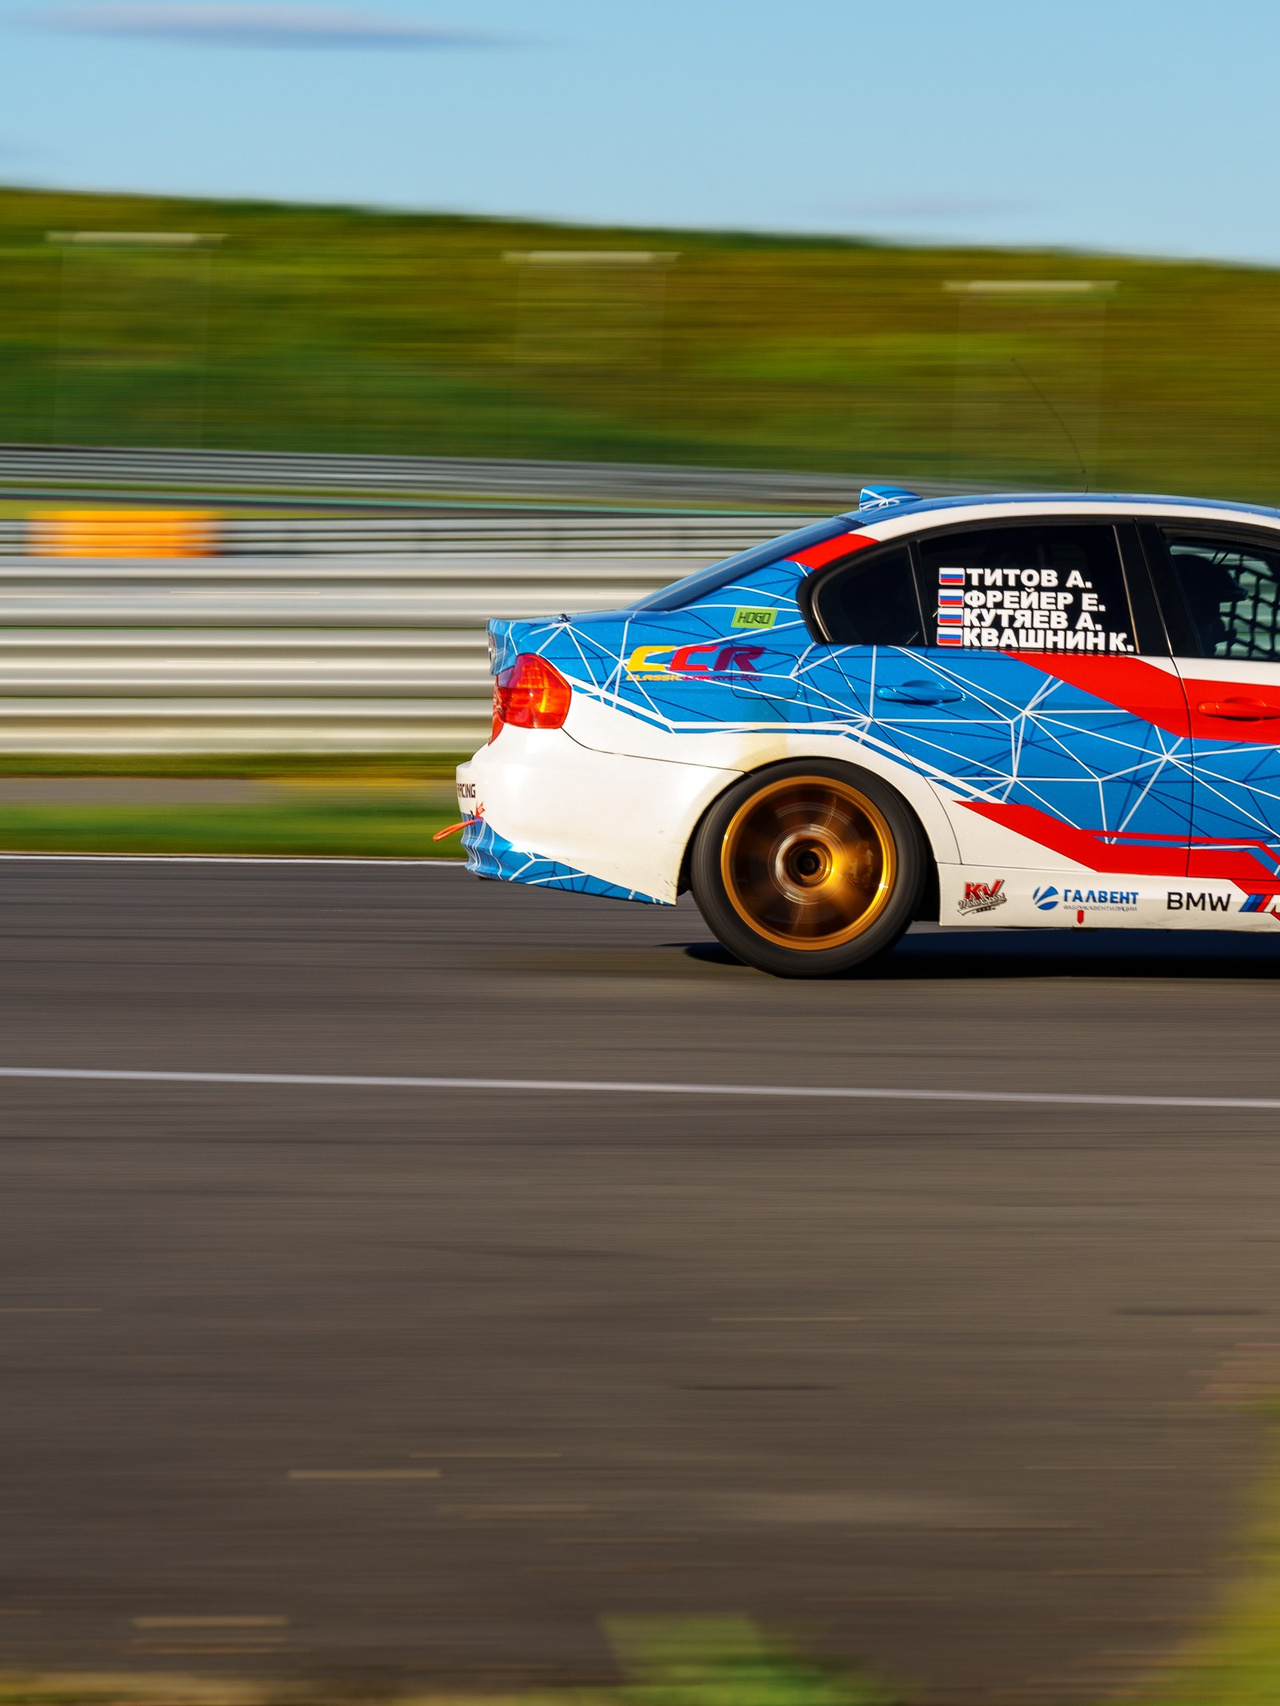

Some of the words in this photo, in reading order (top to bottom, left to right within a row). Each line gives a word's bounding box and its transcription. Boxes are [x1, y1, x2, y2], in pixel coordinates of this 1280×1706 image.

[966, 568, 1059, 588] ТИТОВ
[1065, 570, 1093, 589] А.
[964, 587, 1074, 610] ФРЕЙЕР
[1081, 593, 1106, 612] Е.
[963, 608, 1069, 629] КУТЯЕВ
[1075, 612, 1103, 631] А.
[963, 628, 1106, 651] КВАШНИН
[1109, 632, 1135, 652] К.
[626, 645, 767, 672] CCR
[1064, 889, 1139, 905] ГАЛВЕНТ
[1166, 892, 1231, 911] BMW
